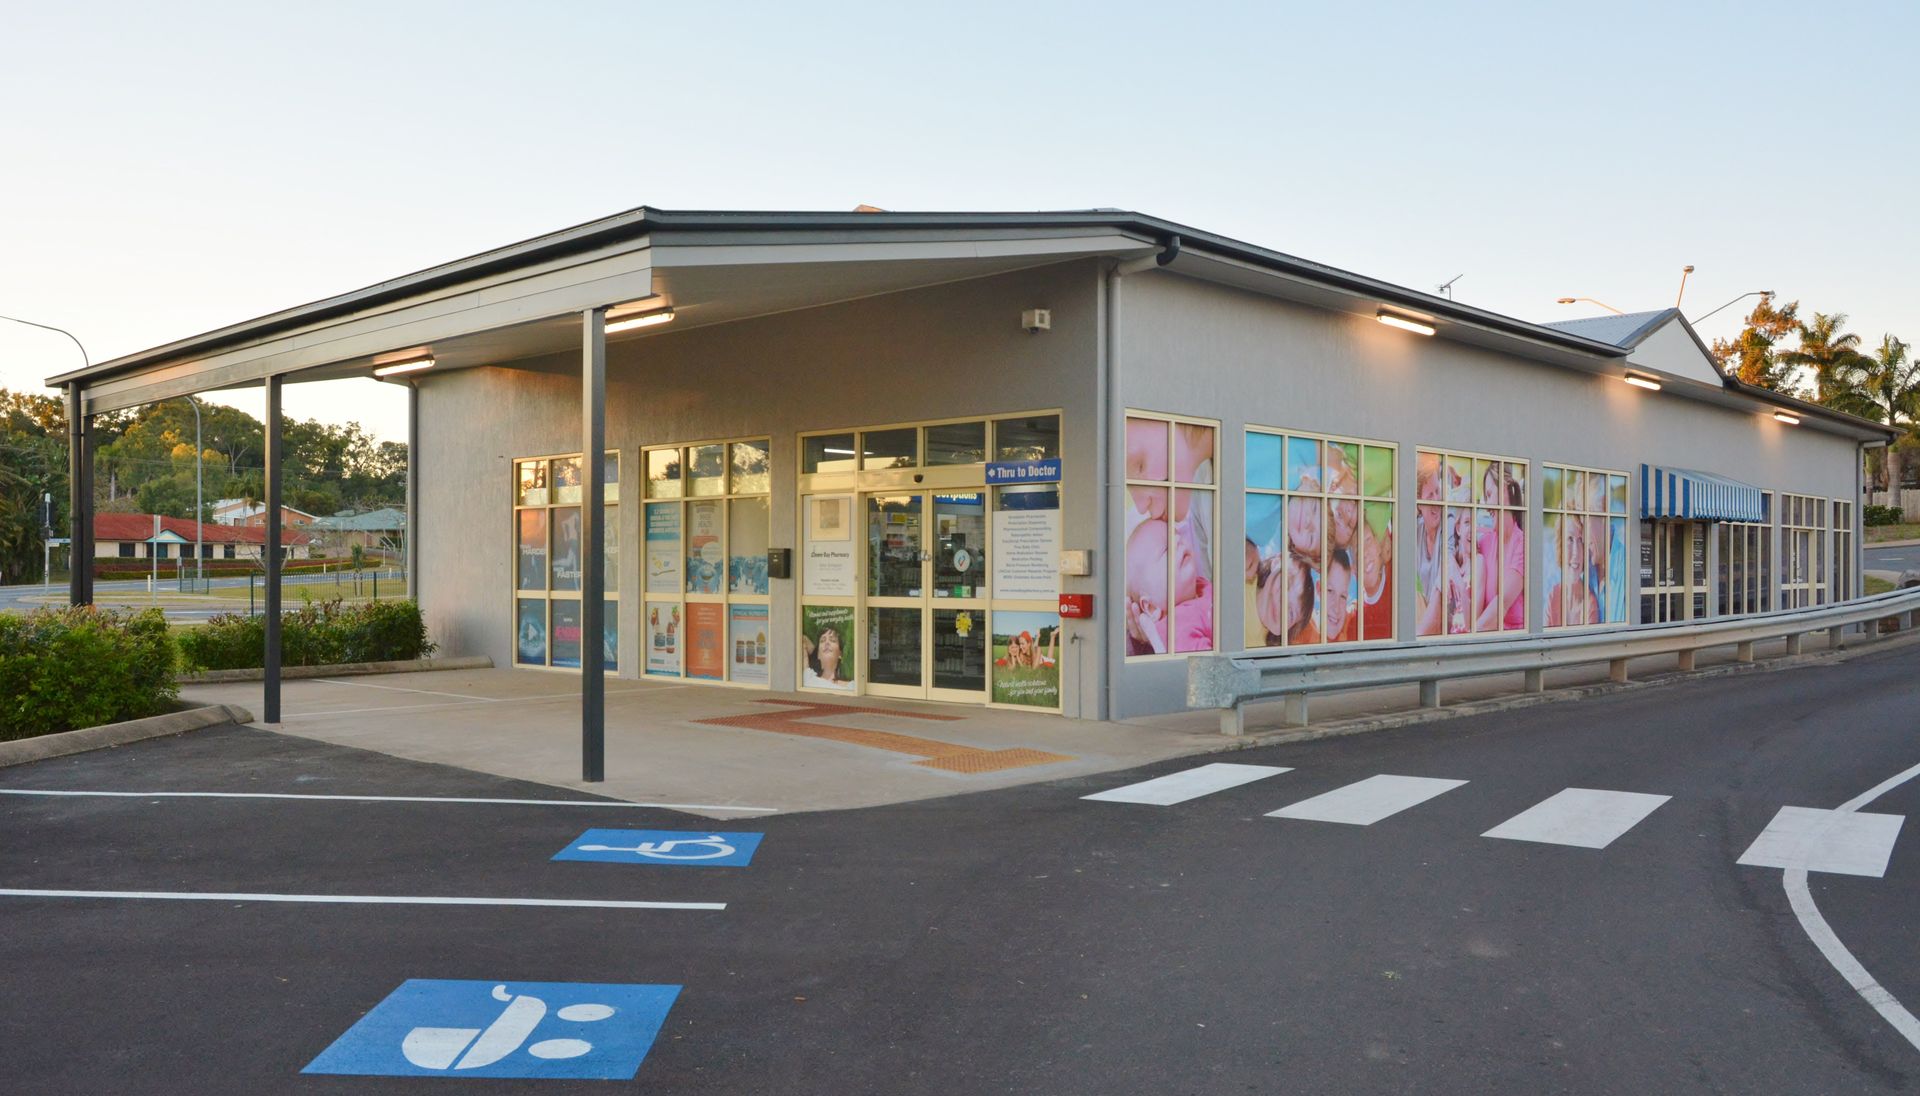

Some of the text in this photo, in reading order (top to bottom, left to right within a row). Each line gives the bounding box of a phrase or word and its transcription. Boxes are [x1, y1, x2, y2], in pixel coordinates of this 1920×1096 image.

[997, 465, 1056, 478] Thru to Doctor
